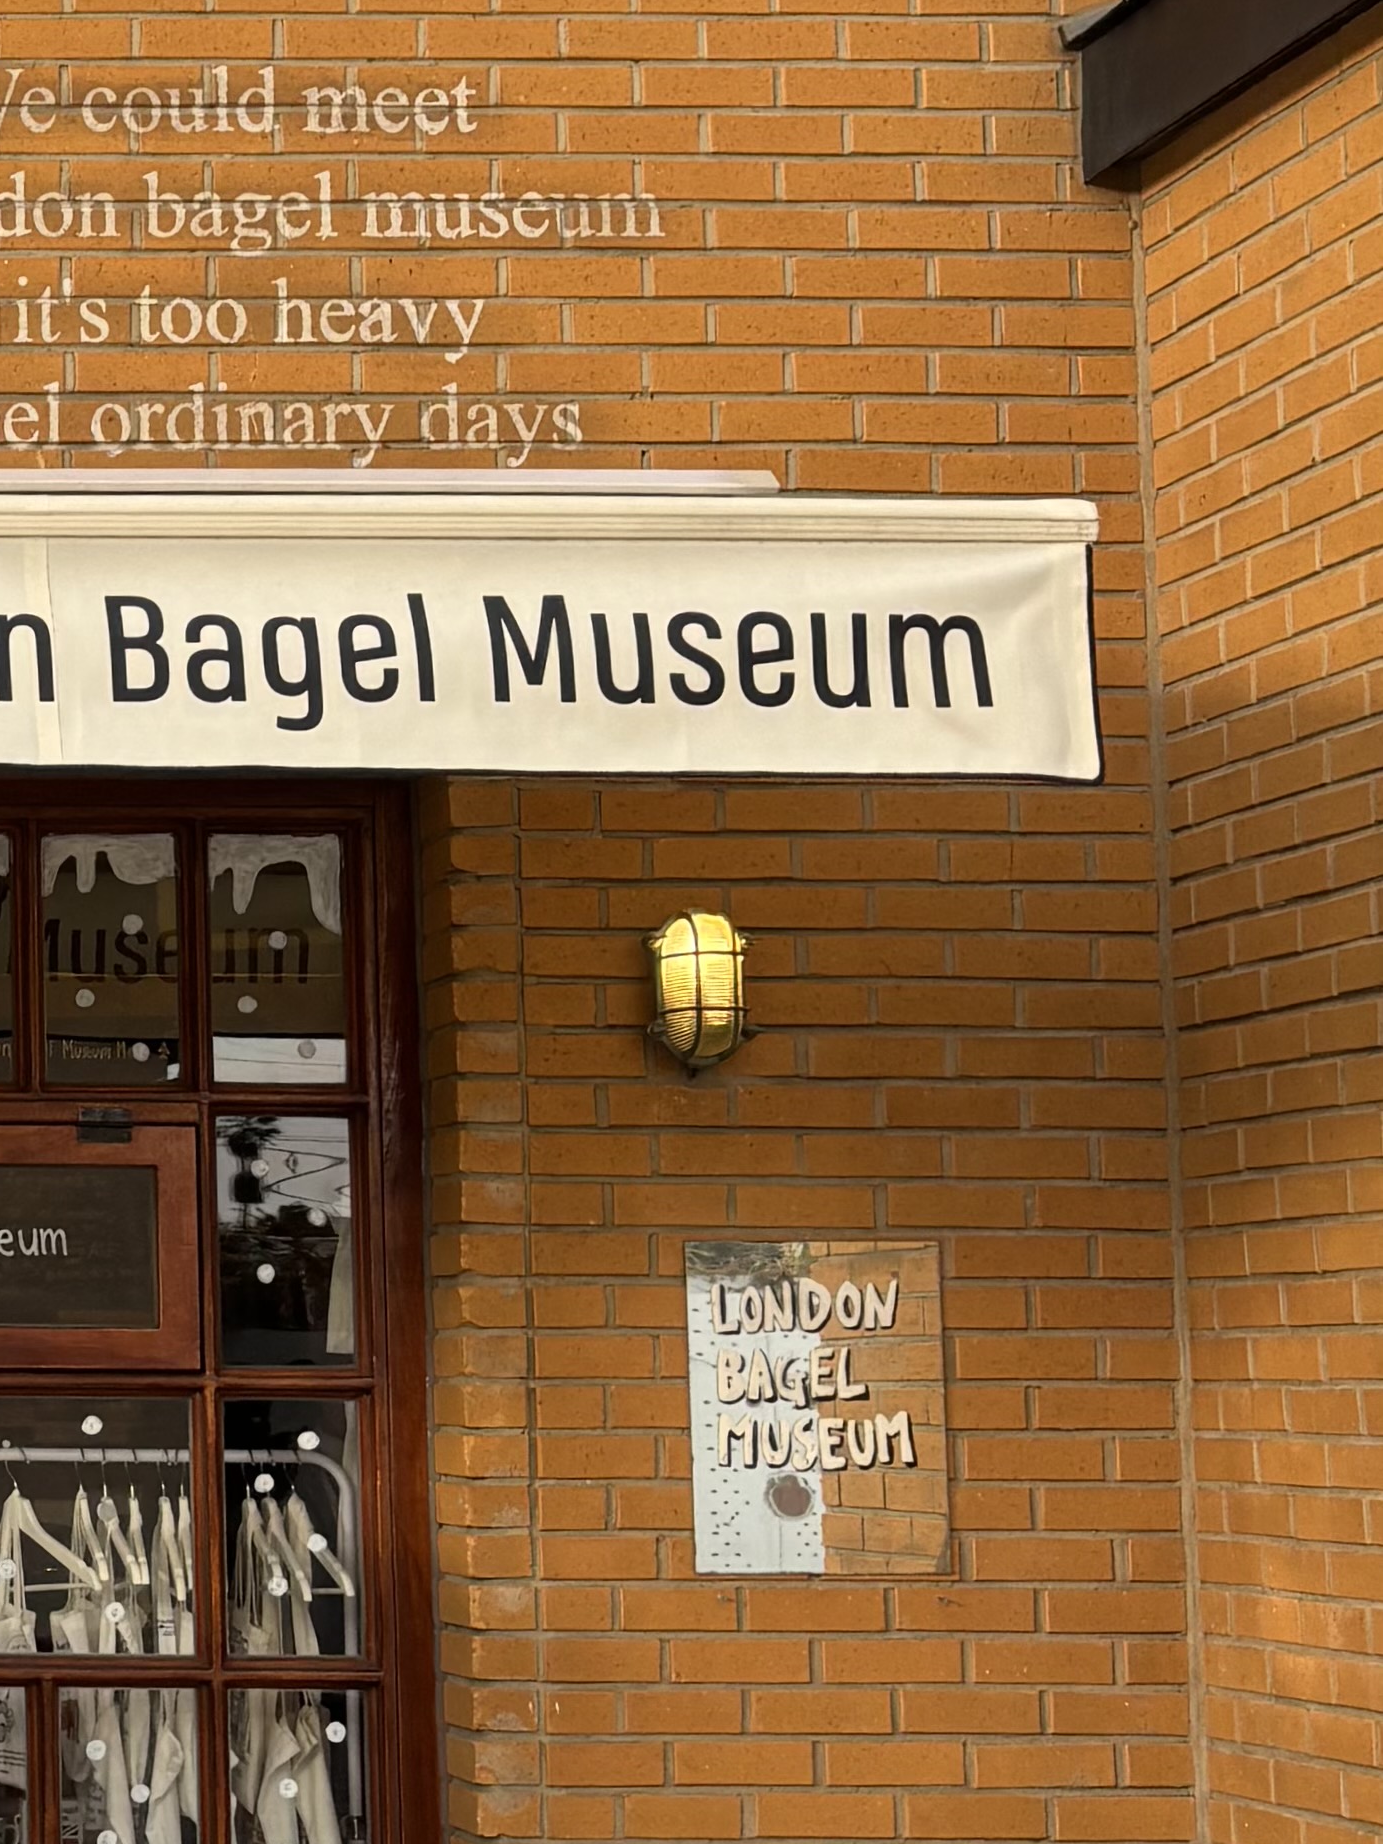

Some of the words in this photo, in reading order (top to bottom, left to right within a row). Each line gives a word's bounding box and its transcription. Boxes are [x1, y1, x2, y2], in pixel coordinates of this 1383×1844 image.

[80, 64, 278, 135] could
[299, 73, 477, 136] meet
[143, 169, 338, 257] bagel
[363, 184, 665, 240] museum
[14, 276, 109, 346] it's
[138, 283, 248, 346] too
[273, 276, 486, 363] heavy
[88, 384, 395, 468] ordinary
[419, 382, 583, 470] days
[103, 592, 436, 732] Bagel
[485, 594, 995, 710] Museum
[710, 1277, 898, 1334] LONDON
[716, 1346, 869, 1408] BAGEL
[717, 1411, 917, 1472] MUSEUM
